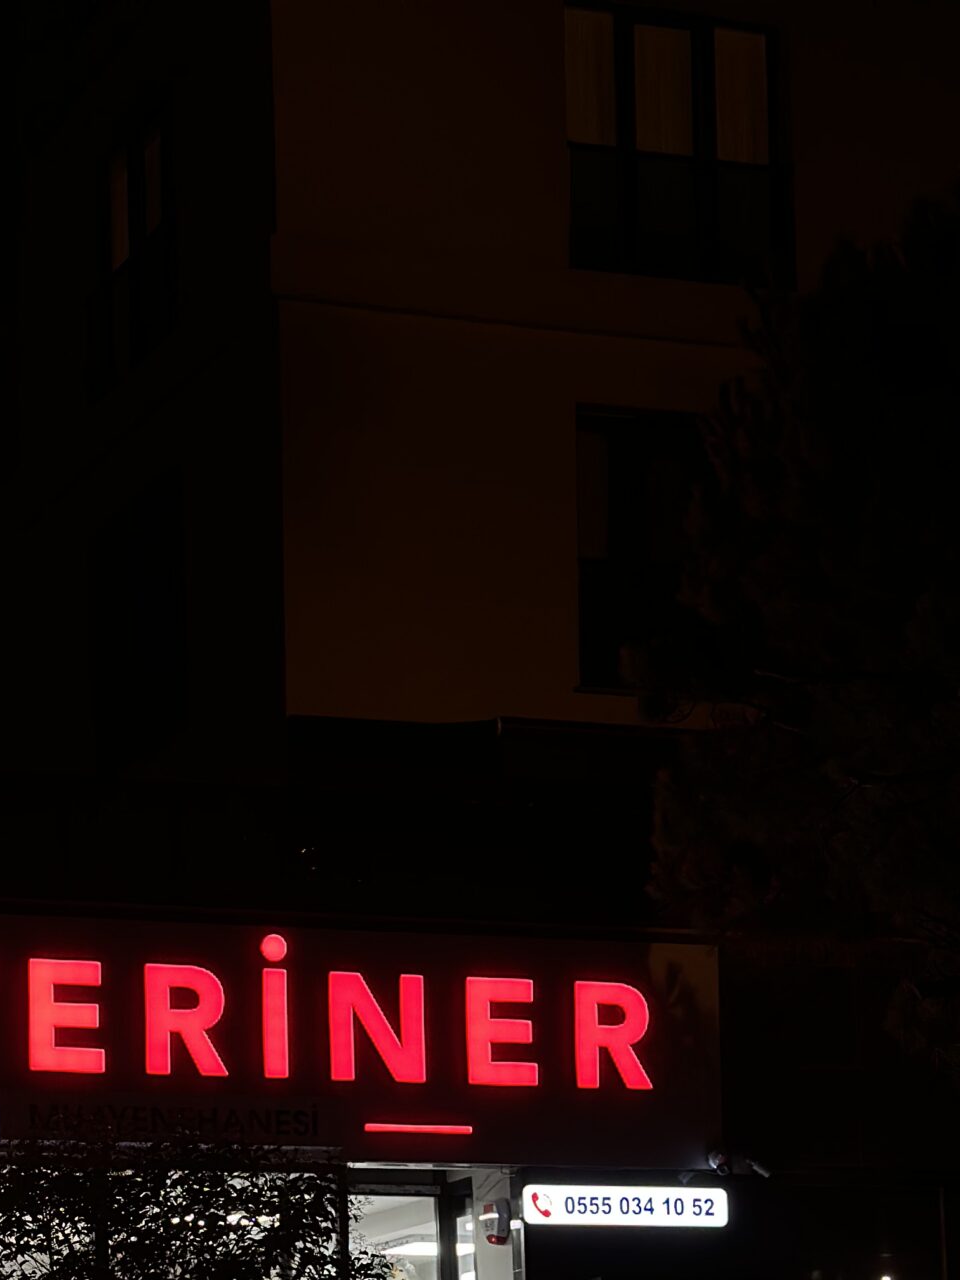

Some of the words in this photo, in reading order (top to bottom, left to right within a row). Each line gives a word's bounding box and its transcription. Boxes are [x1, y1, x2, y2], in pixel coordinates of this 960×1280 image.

[564, 1196, 612, 1215] 0555
[619, 1196, 655, 1216] 034
[662, 1197, 685, 1216] 10
[692, 1198, 715, 1217] 52
